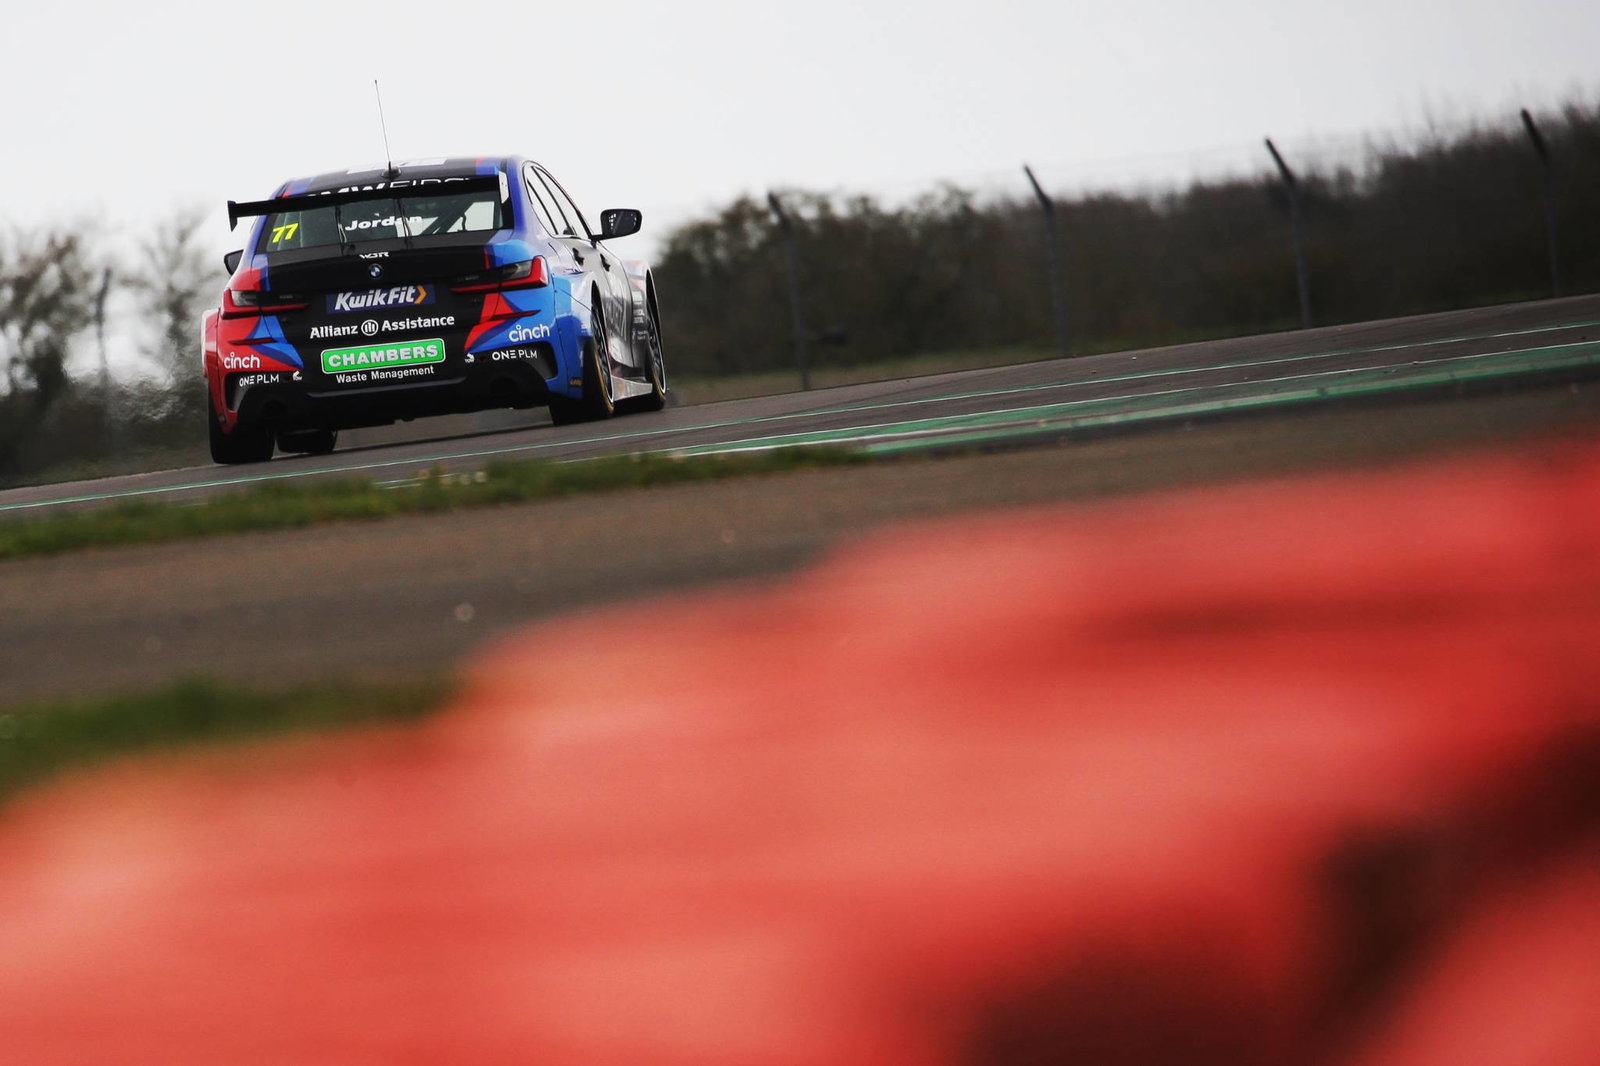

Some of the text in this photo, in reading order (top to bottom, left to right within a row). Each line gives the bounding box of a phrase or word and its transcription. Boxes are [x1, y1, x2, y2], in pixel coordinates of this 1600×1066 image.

[272, 222, 299, 243] 77
[310, 316, 455, 339] Allianz Assistance
[508, 324, 550, 342] cinch
[223, 352, 260, 369] cinch
[328, 344, 438, 367] CHAMBERS
[491, 349, 538, 361] ONE PLM
[239, 375, 255, 388] ONE
[256, 374, 280, 384] PLM
[336, 365, 434, 384] Waste Management
